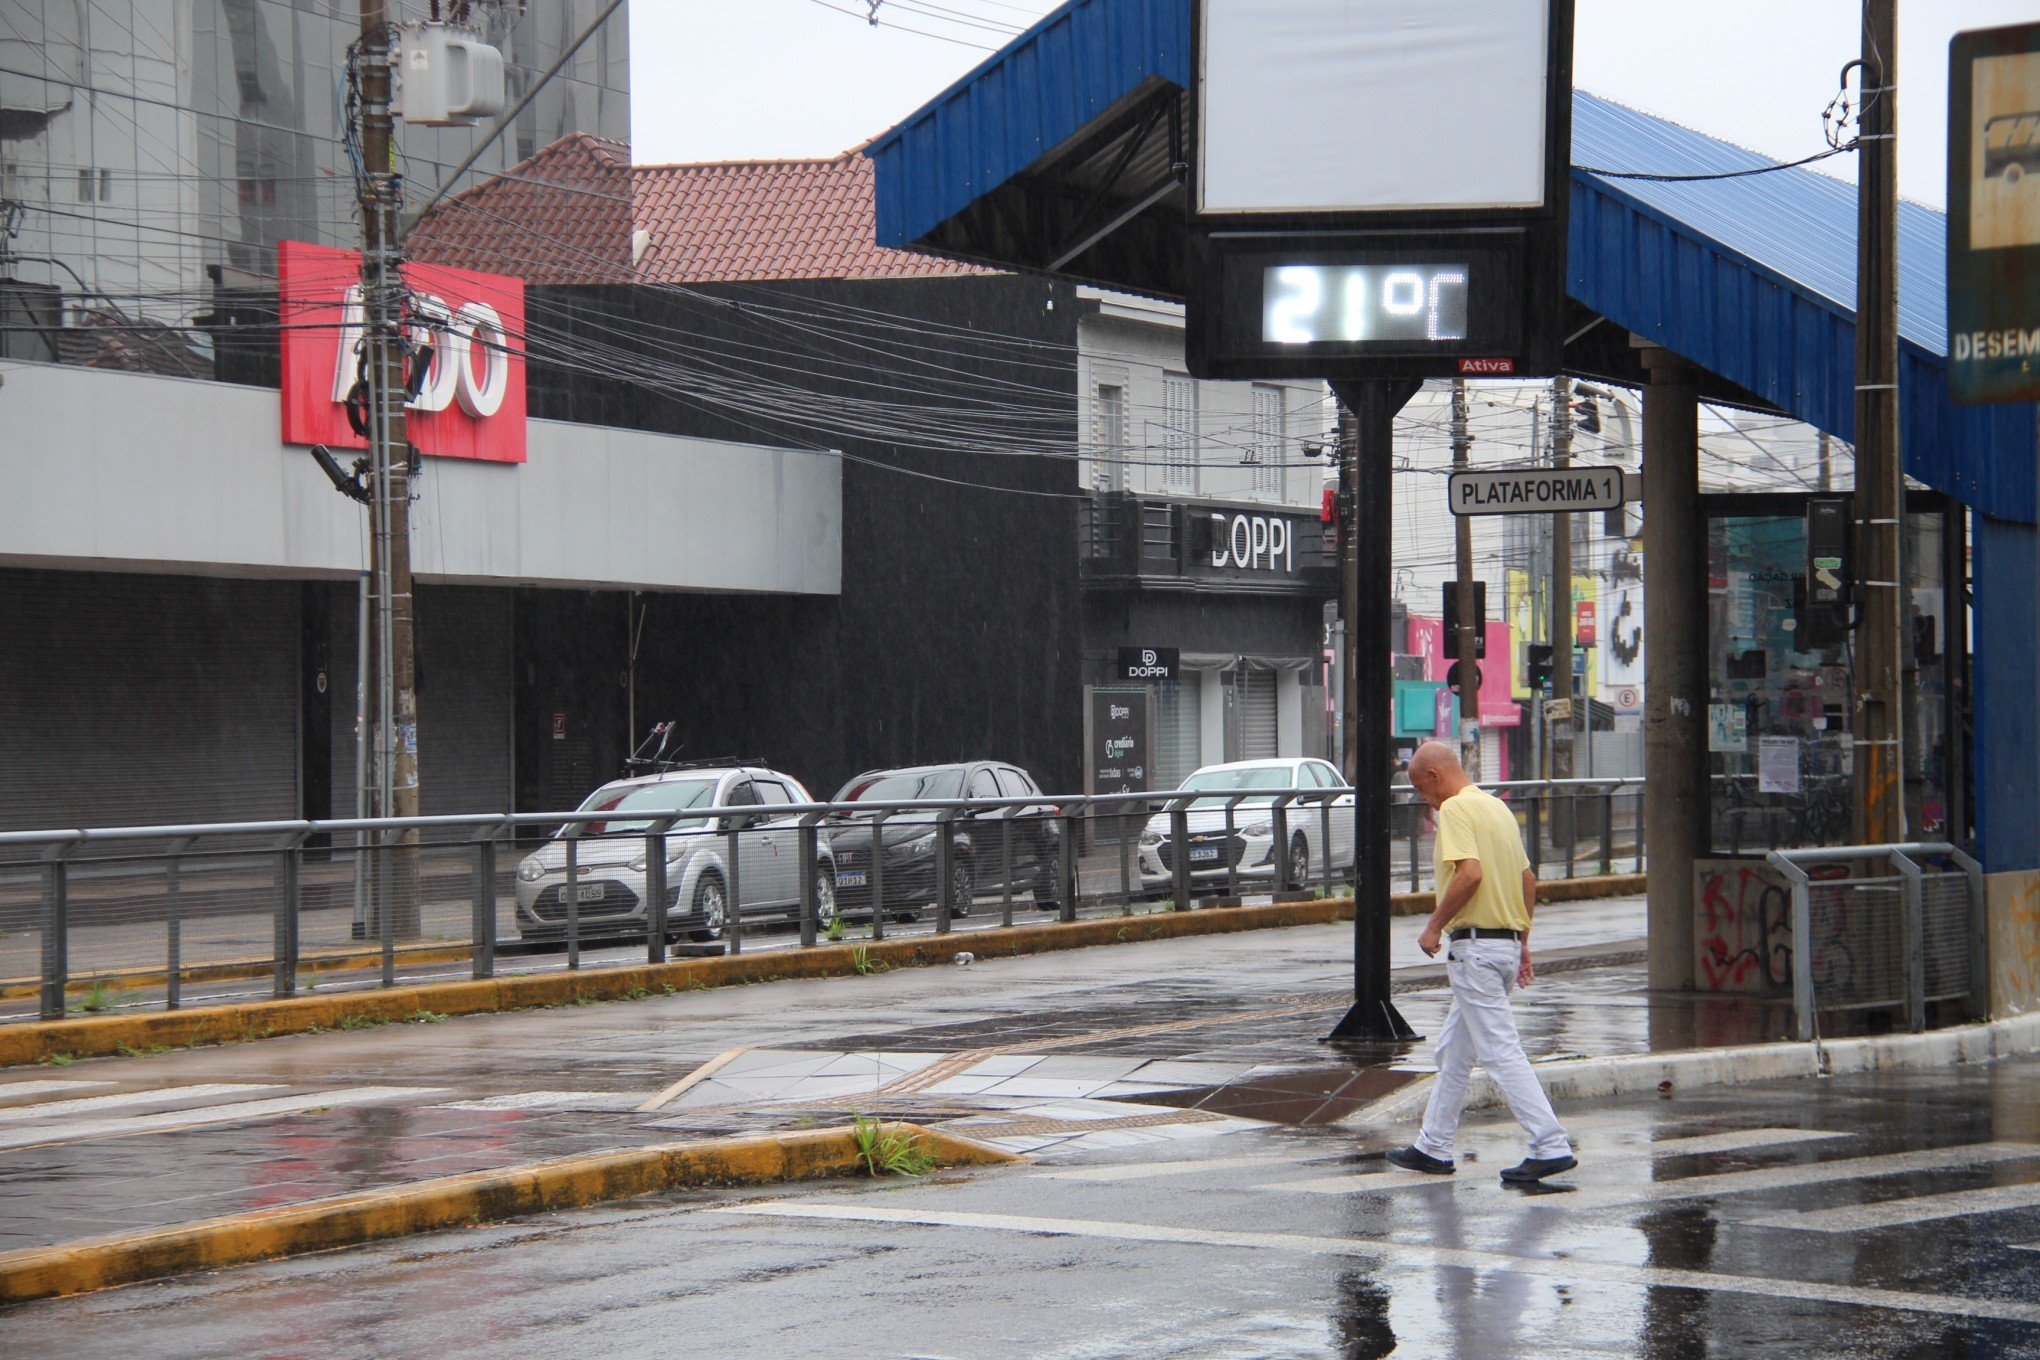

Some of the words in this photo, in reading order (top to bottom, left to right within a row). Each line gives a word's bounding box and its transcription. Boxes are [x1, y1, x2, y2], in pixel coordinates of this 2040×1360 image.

[1462, 359, 1510, 372] Ativa
[1462, 478, 1597, 504] PLATAFORMA
[1603, 478, 1611, 499] 1
[1128, 666, 1168, 677] DOPPI
